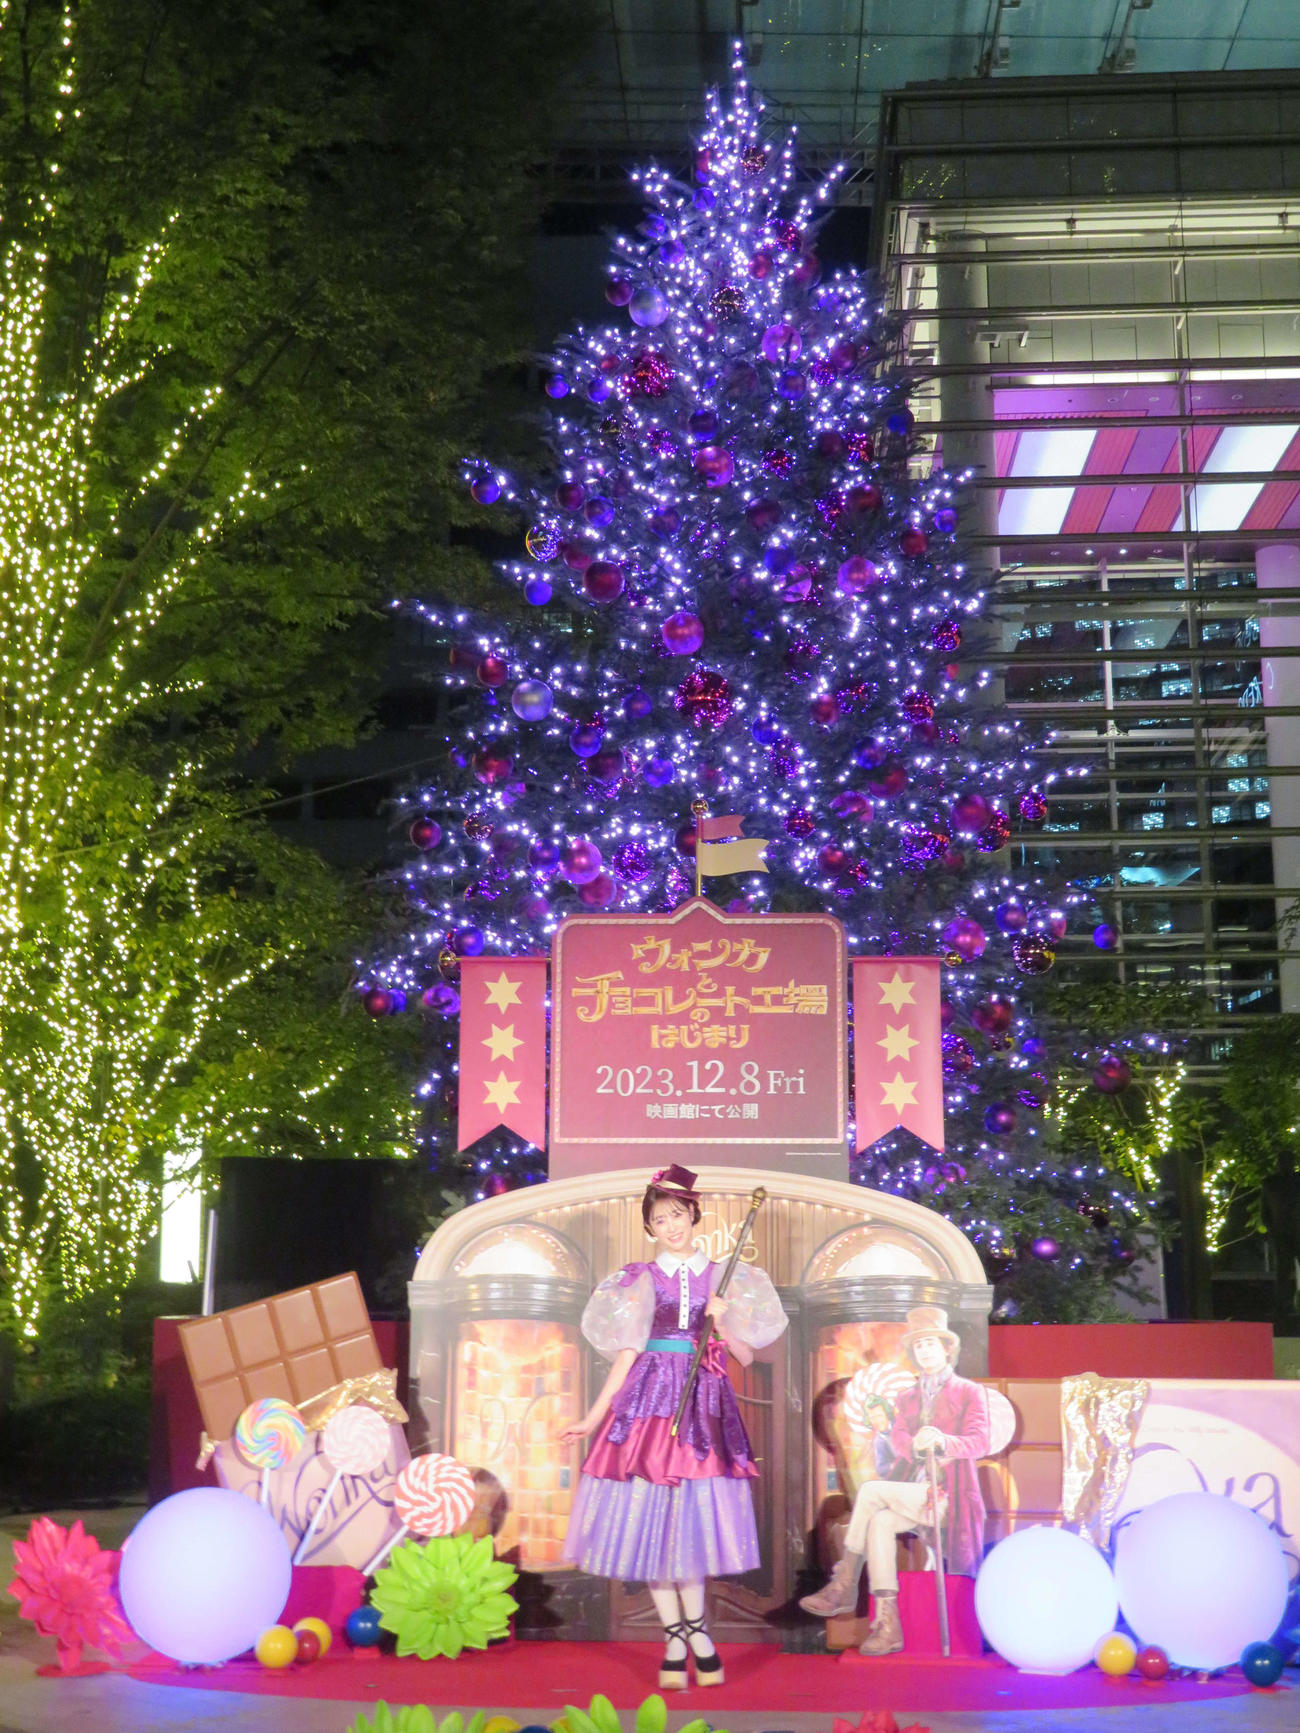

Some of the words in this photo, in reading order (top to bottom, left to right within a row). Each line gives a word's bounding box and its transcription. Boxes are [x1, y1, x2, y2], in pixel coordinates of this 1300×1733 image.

[630, 935, 771, 974] ウォンカ
[697, 972, 718, 993] と
[572, 970, 828, 1023] チョコレート工場
[690, 1008, 711, 1023] の
[651, 1023, 750, 1049] はじまり
[595, 1059, 761, 1097] 2023.12.8
[766, 1068, 806, 1095] Fri
[645, 1103, 759, 1120] 映画館にて公開
